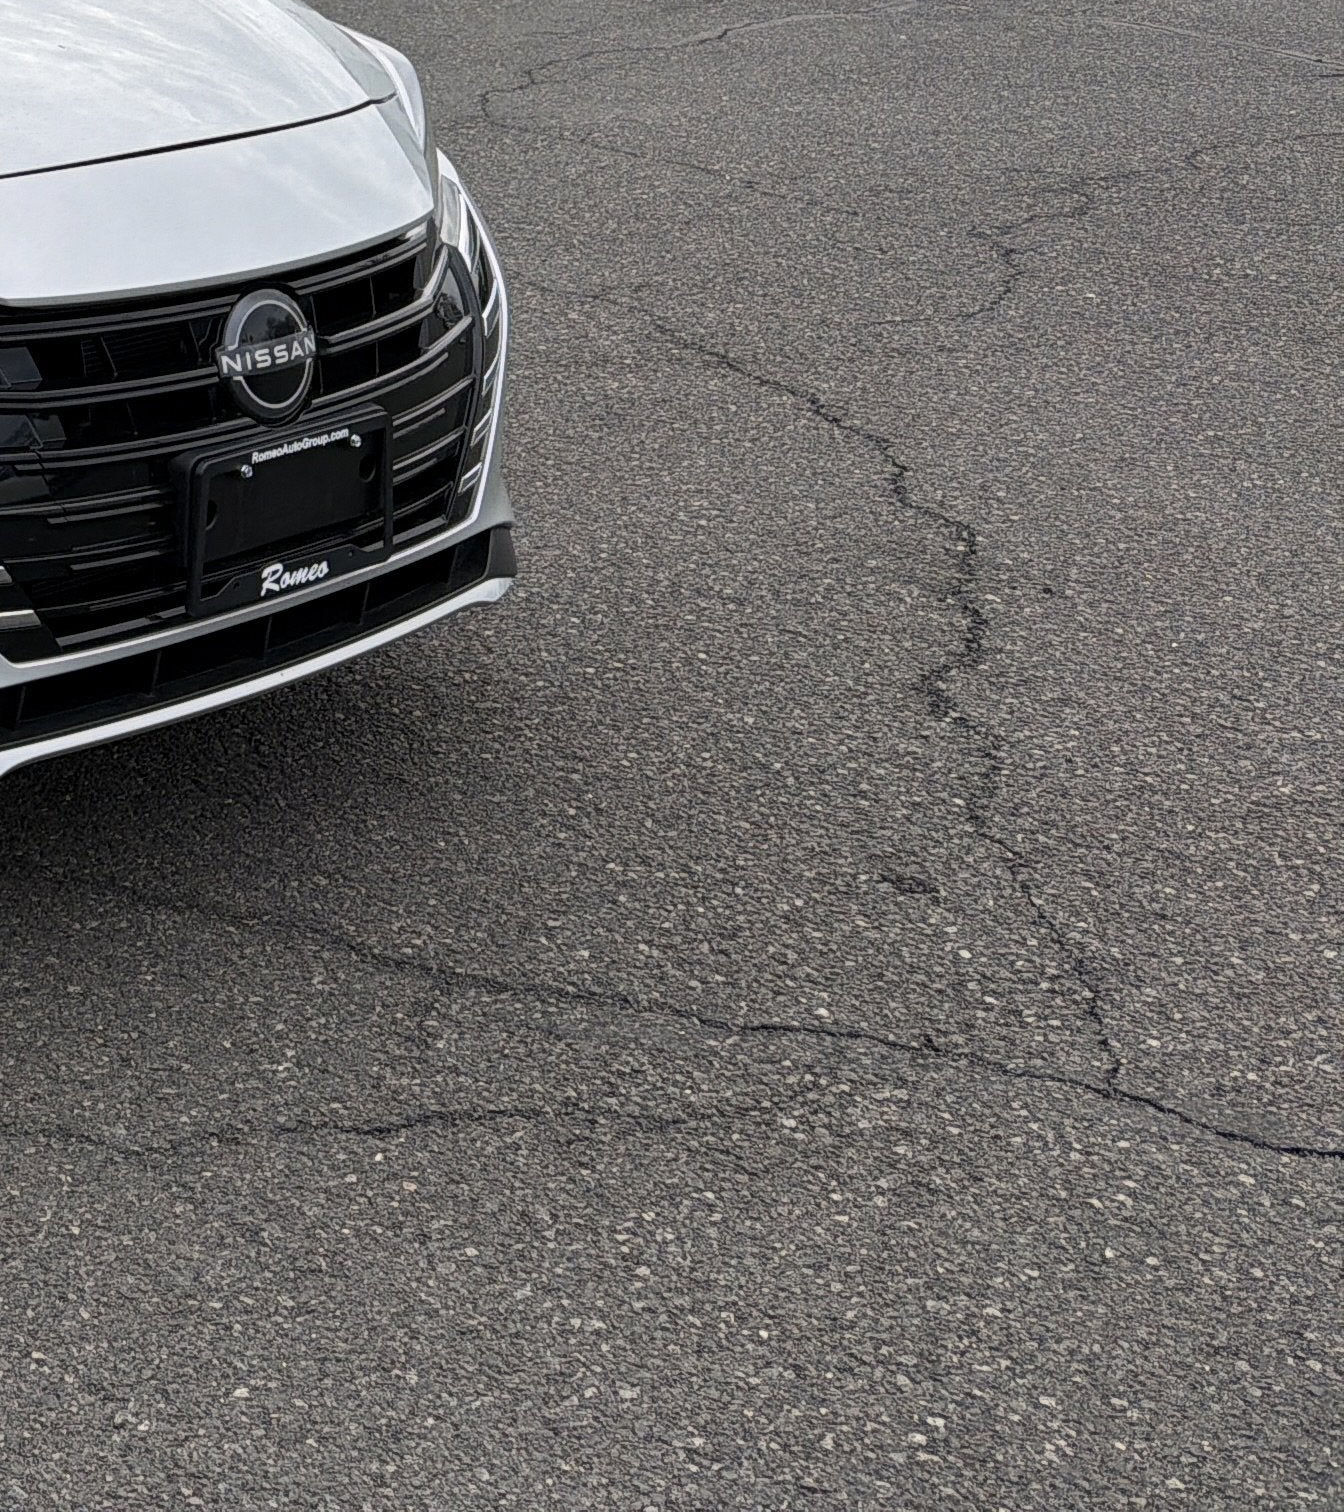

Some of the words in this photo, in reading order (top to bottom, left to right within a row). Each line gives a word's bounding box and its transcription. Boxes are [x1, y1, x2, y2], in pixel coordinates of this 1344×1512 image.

[220, 332, 316, 374] NISSAN
[252, 428, 349, 464] RomeoAutoGroup.com
[260, 560, 330, 597] Romeo
